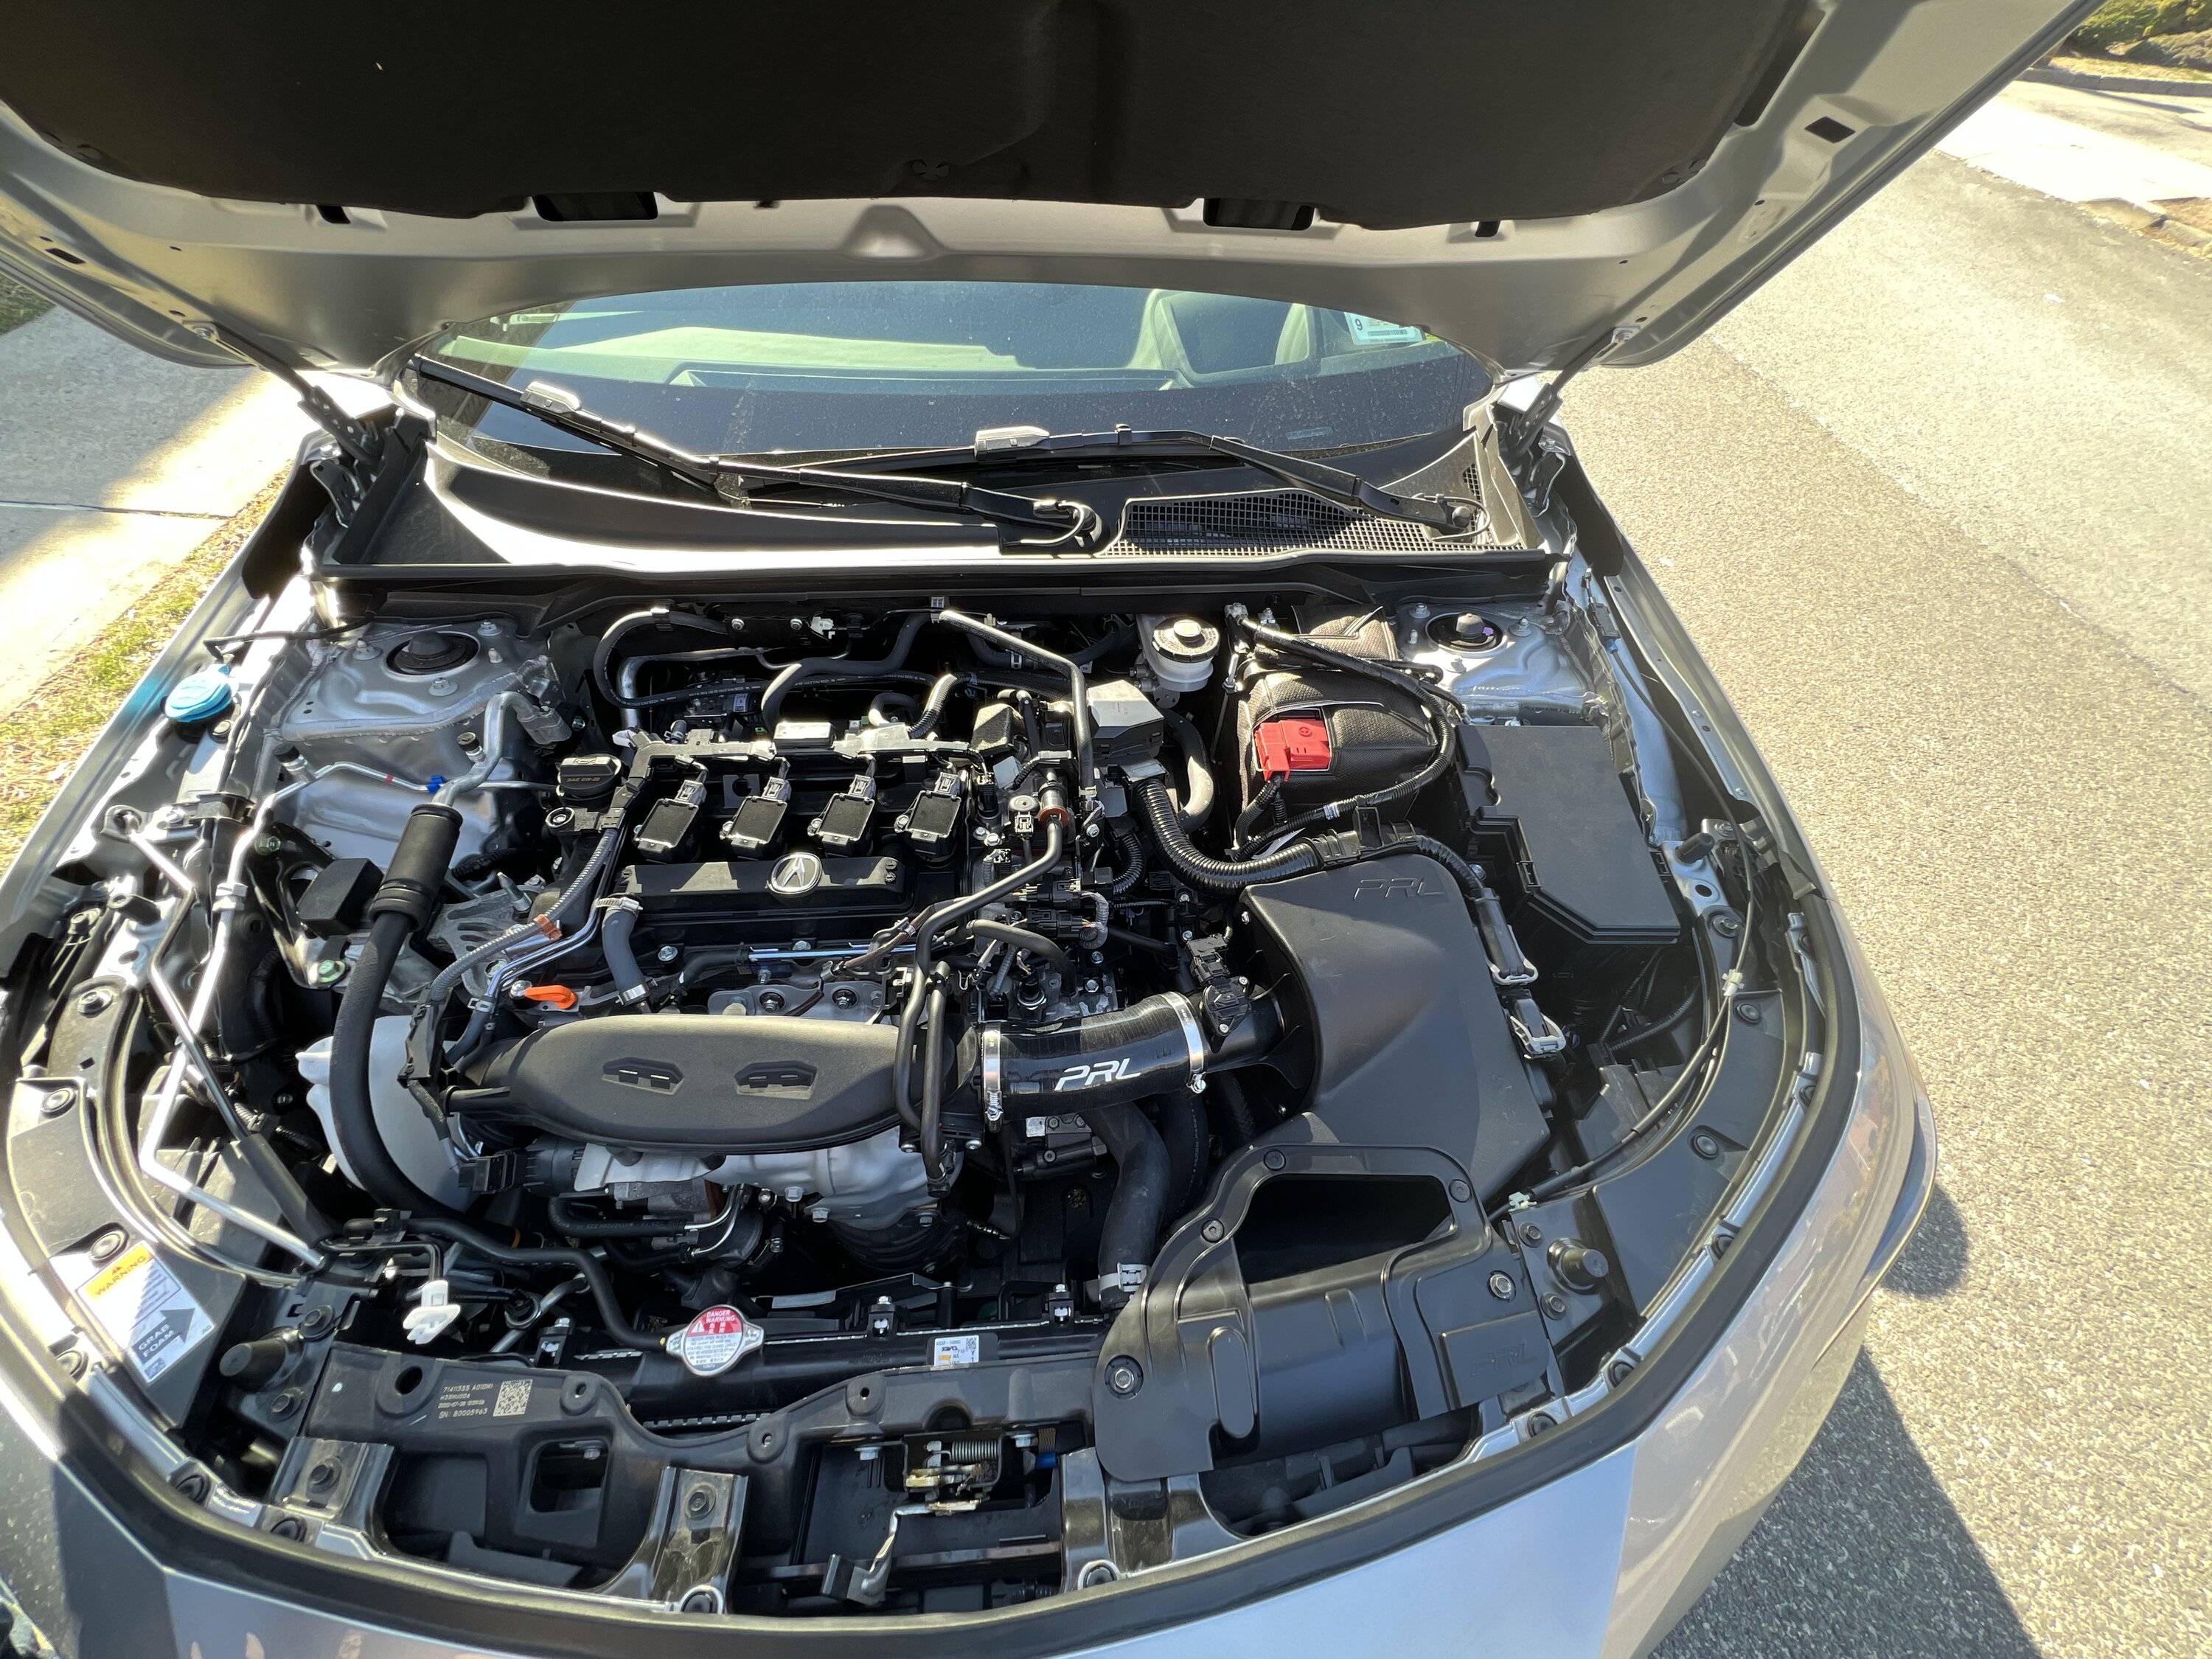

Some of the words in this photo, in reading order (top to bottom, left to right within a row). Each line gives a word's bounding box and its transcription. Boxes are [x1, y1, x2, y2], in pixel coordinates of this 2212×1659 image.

[1352, 877, 1446, 900] PRL
[1054, 1057, 1141, 1092] PRL
[95, 1256, 146, 1295] WARNING
[706, 1315, 735, 1323] WARNUNG
[139, 1324, 170, 1350] GRAB
[142, 1330, 175, 1357] FOAM
